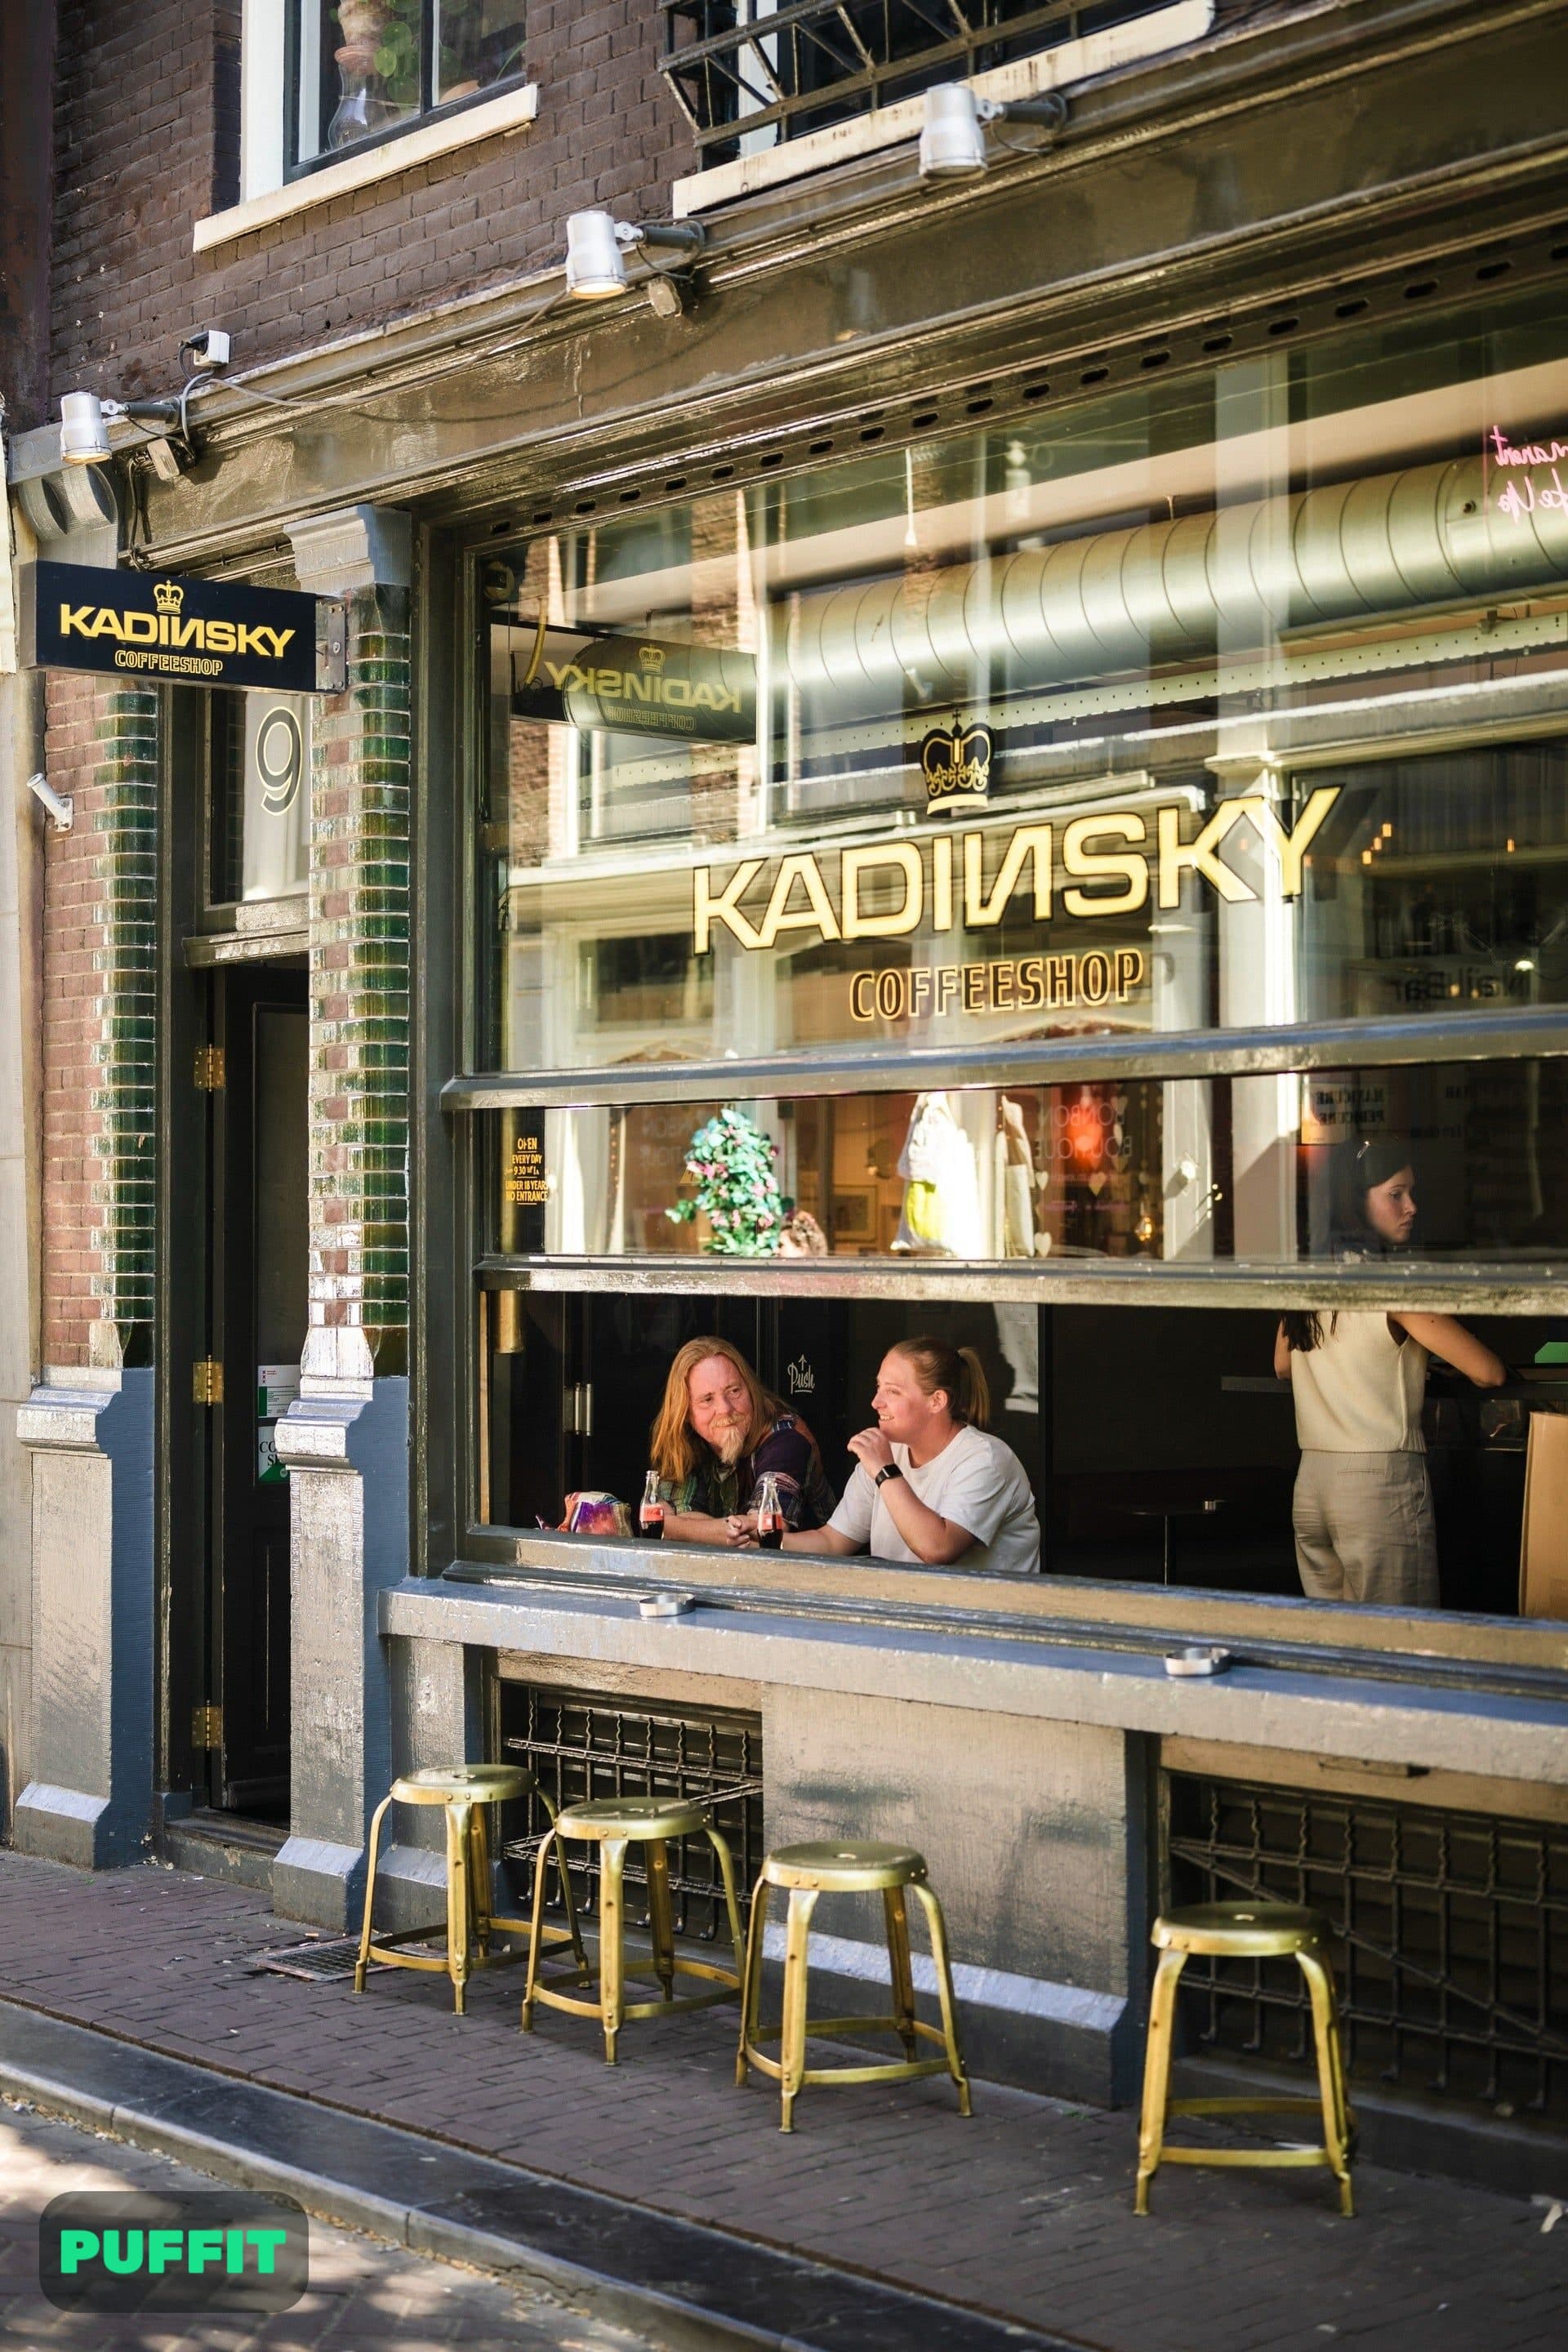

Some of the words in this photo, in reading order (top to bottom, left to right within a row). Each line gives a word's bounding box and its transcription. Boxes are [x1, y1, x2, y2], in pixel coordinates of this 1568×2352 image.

[114, 650, 223, 676] COFFEESHOP
[255, 705, 303, 816] 9
[849, 947, 1144, 1022] COFFEESHOP
[517, 1137, 537, 1151] OPEN
[512, 1153, 530, 1164] EVERY
[531, 1153, 542, 1164] DAY
[505, 1180, 523, 1190] UNDER
[506, 1191, 515, 1201] NO
[516, 1191, 548, 1201] ENTRANCE
[787, 1361, 815, 1395] Push
